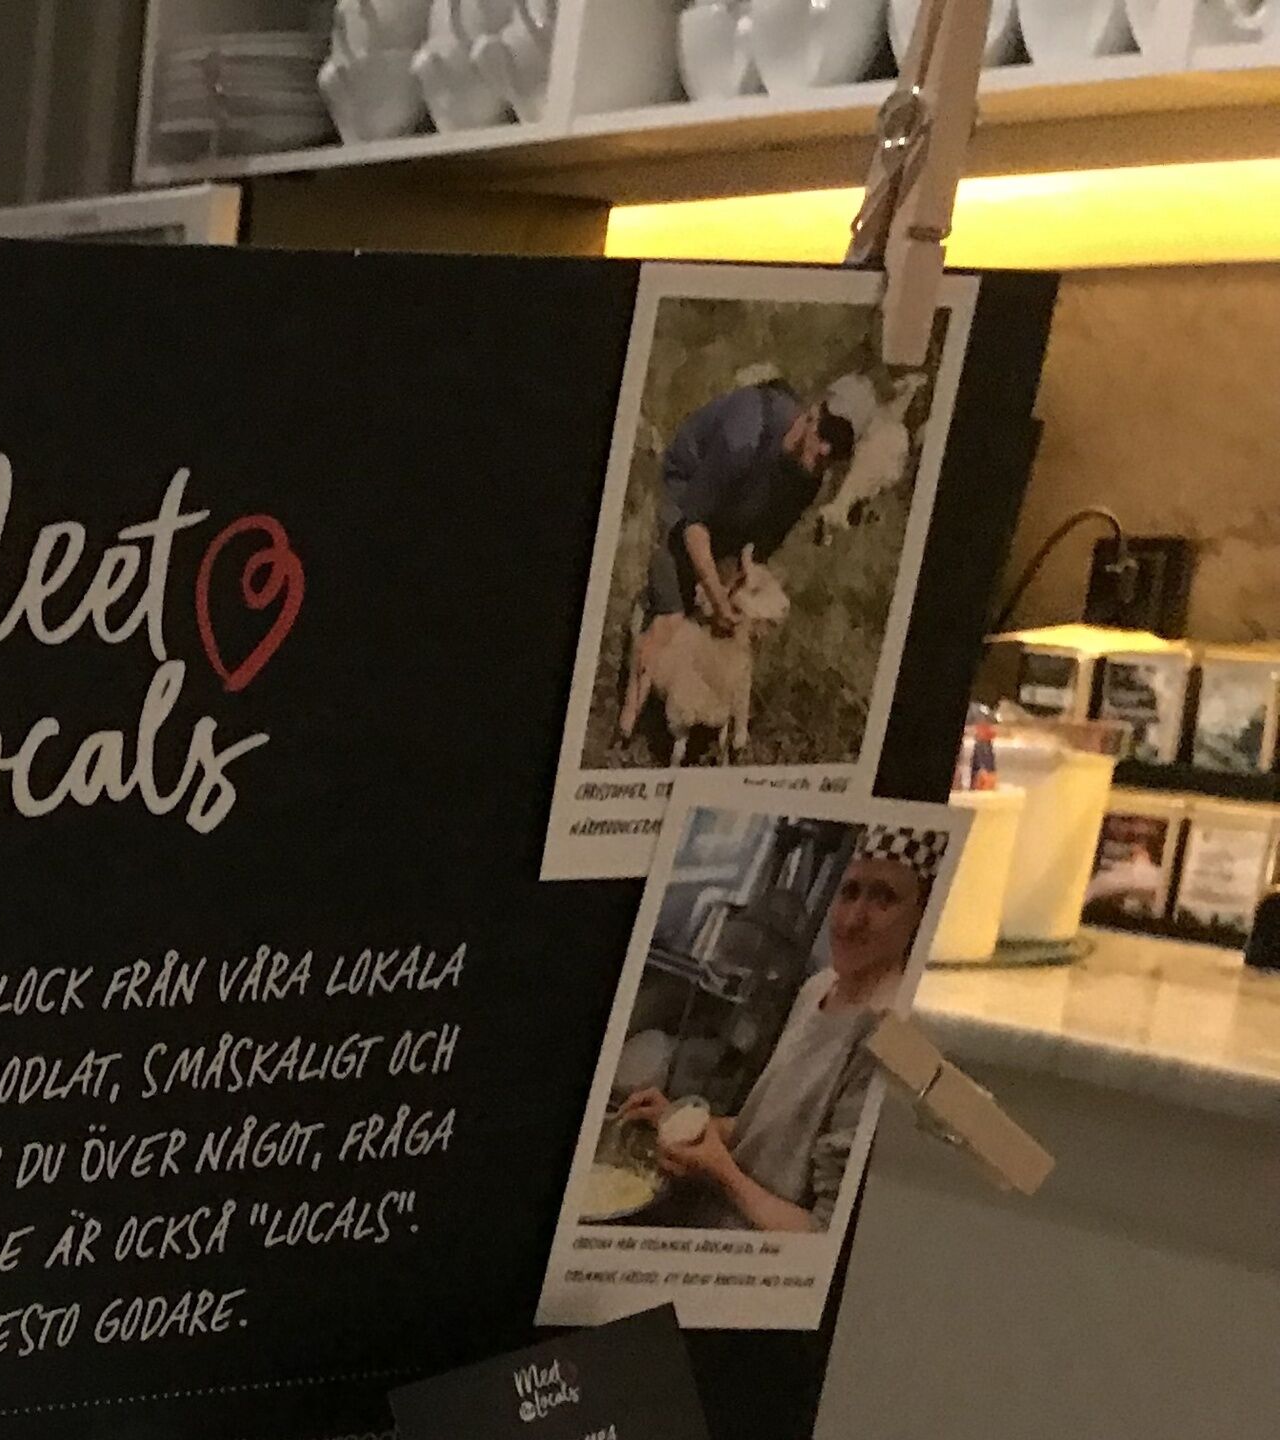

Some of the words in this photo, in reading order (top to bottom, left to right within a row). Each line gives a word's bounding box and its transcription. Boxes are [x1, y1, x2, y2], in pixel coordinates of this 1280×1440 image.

[102, 952, 205, 1009] FRÅN
[217, 943, 314, 1003] VÅRA
[325, 943, 468, 995] LOKALA
[141, 1031, 379, 1098] SMÅSKALIGT
[388, 1025, 461, 1076] OCH
[14, 1142, 67, 1189] DU
[80, 1125, 187, 1184] ÖVER
[195, 1115, 325, 1171] NÅGOT,
[338, 1104, 455, 1165] FRÅGA
[43, 1209, 103, 1269] ÄR
[113, 1199, 232, 1261] OCKSÅ
[93, 1288, 249, 1341] GODARE.
